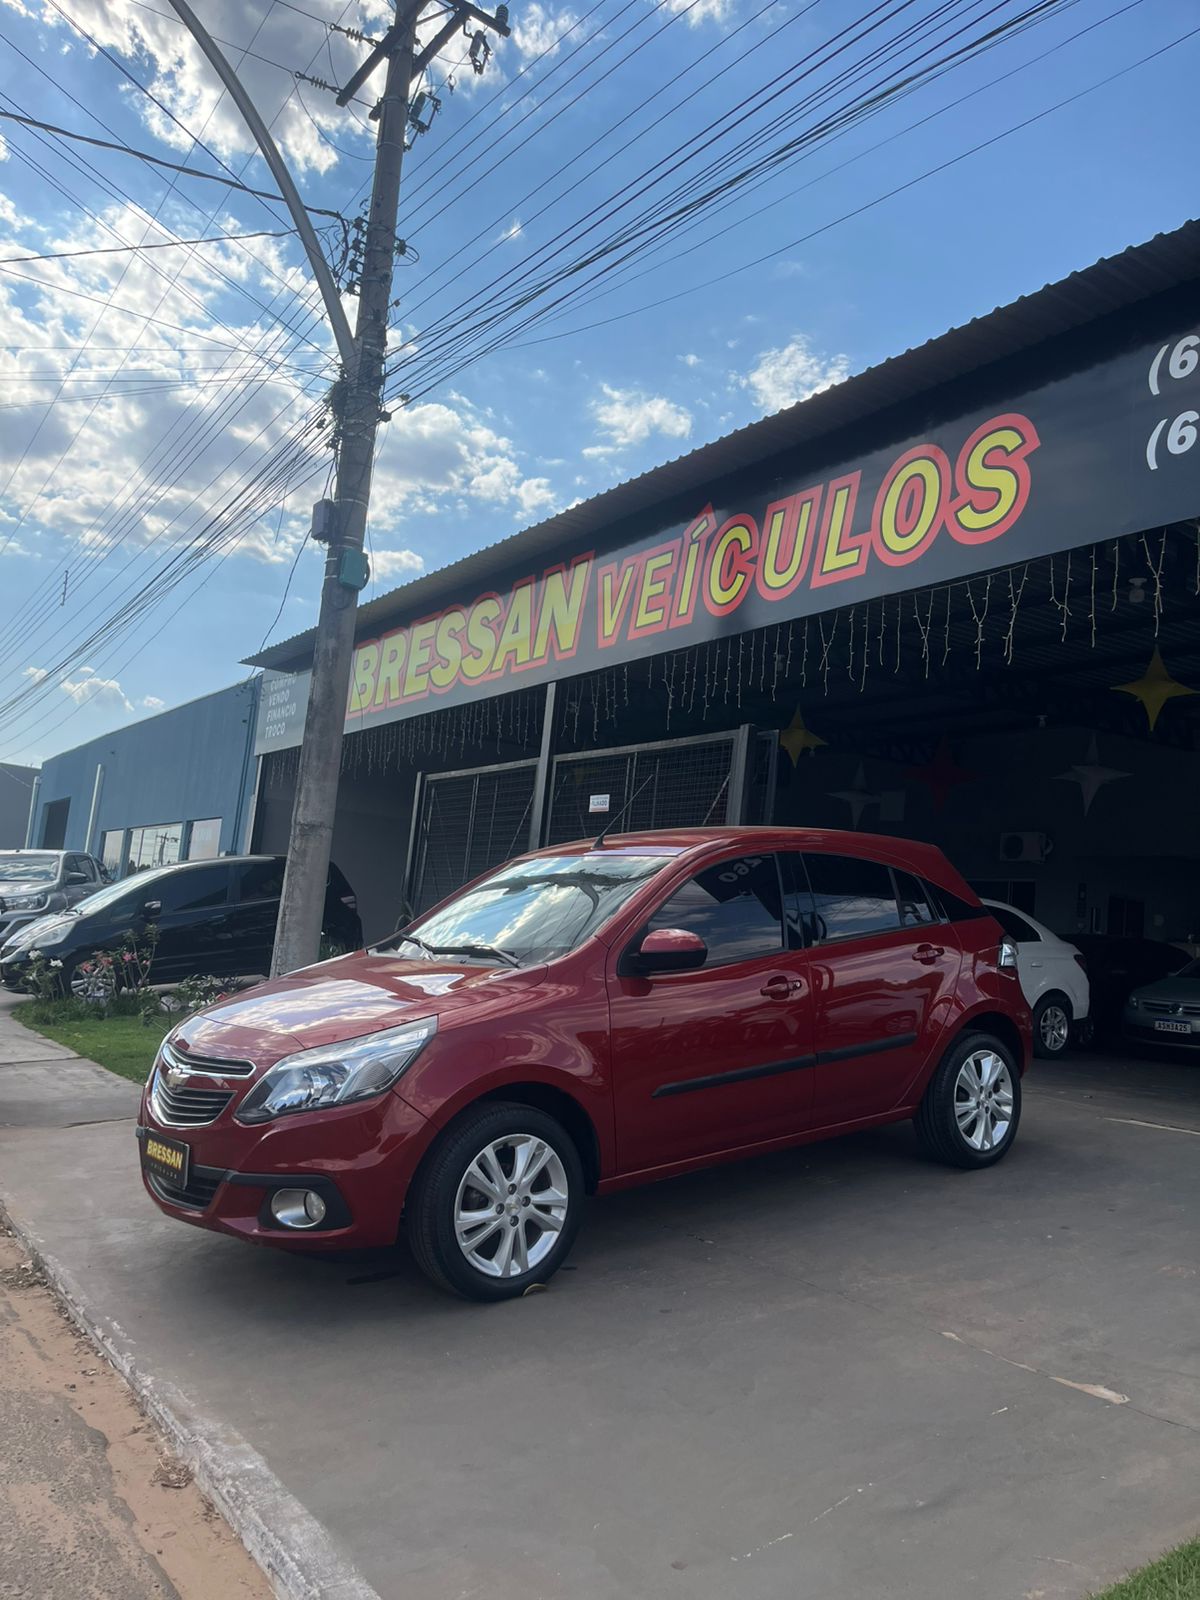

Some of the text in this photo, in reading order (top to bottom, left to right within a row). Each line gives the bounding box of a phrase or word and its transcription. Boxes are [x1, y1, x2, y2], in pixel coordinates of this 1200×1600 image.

[346, 416, 1038, 716] BRESSAN VEÍCULOS
[268, 688, 290, 707] VENDO
[266, 702, 297, 723] FINANCIO
[264, 721, 286, 739] TROCO
[146, 1139, 183, 1170] BRESSAN
